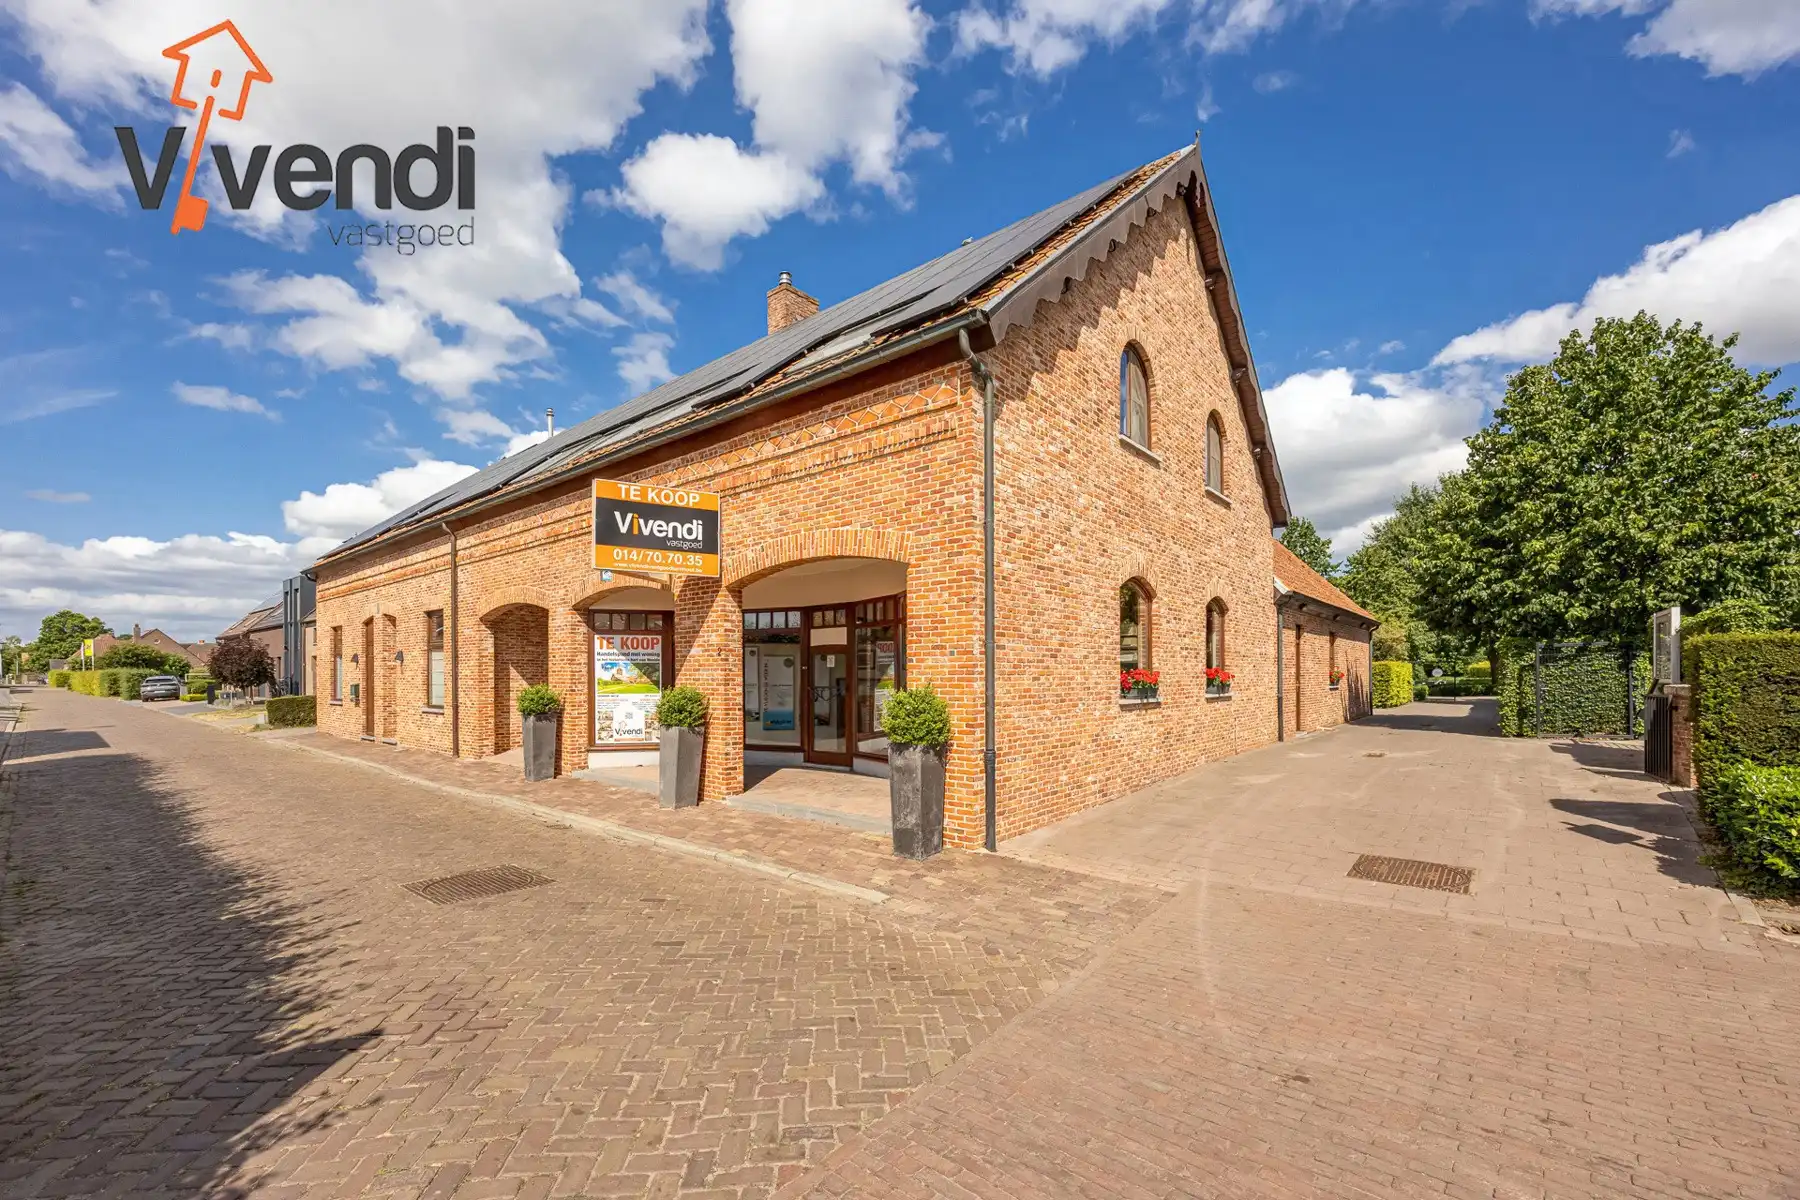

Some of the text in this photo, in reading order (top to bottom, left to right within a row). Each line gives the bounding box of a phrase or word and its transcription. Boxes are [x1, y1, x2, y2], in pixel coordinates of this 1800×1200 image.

[617, 484, 700, 507] TE KOOP
[613, 510, 703, 541] Vivendi
[666, 540, 703, 551] vastgoed
[613, 548, 703, 567] 014/70.70.35
[596, 636, 660, 650] TE KOOP
